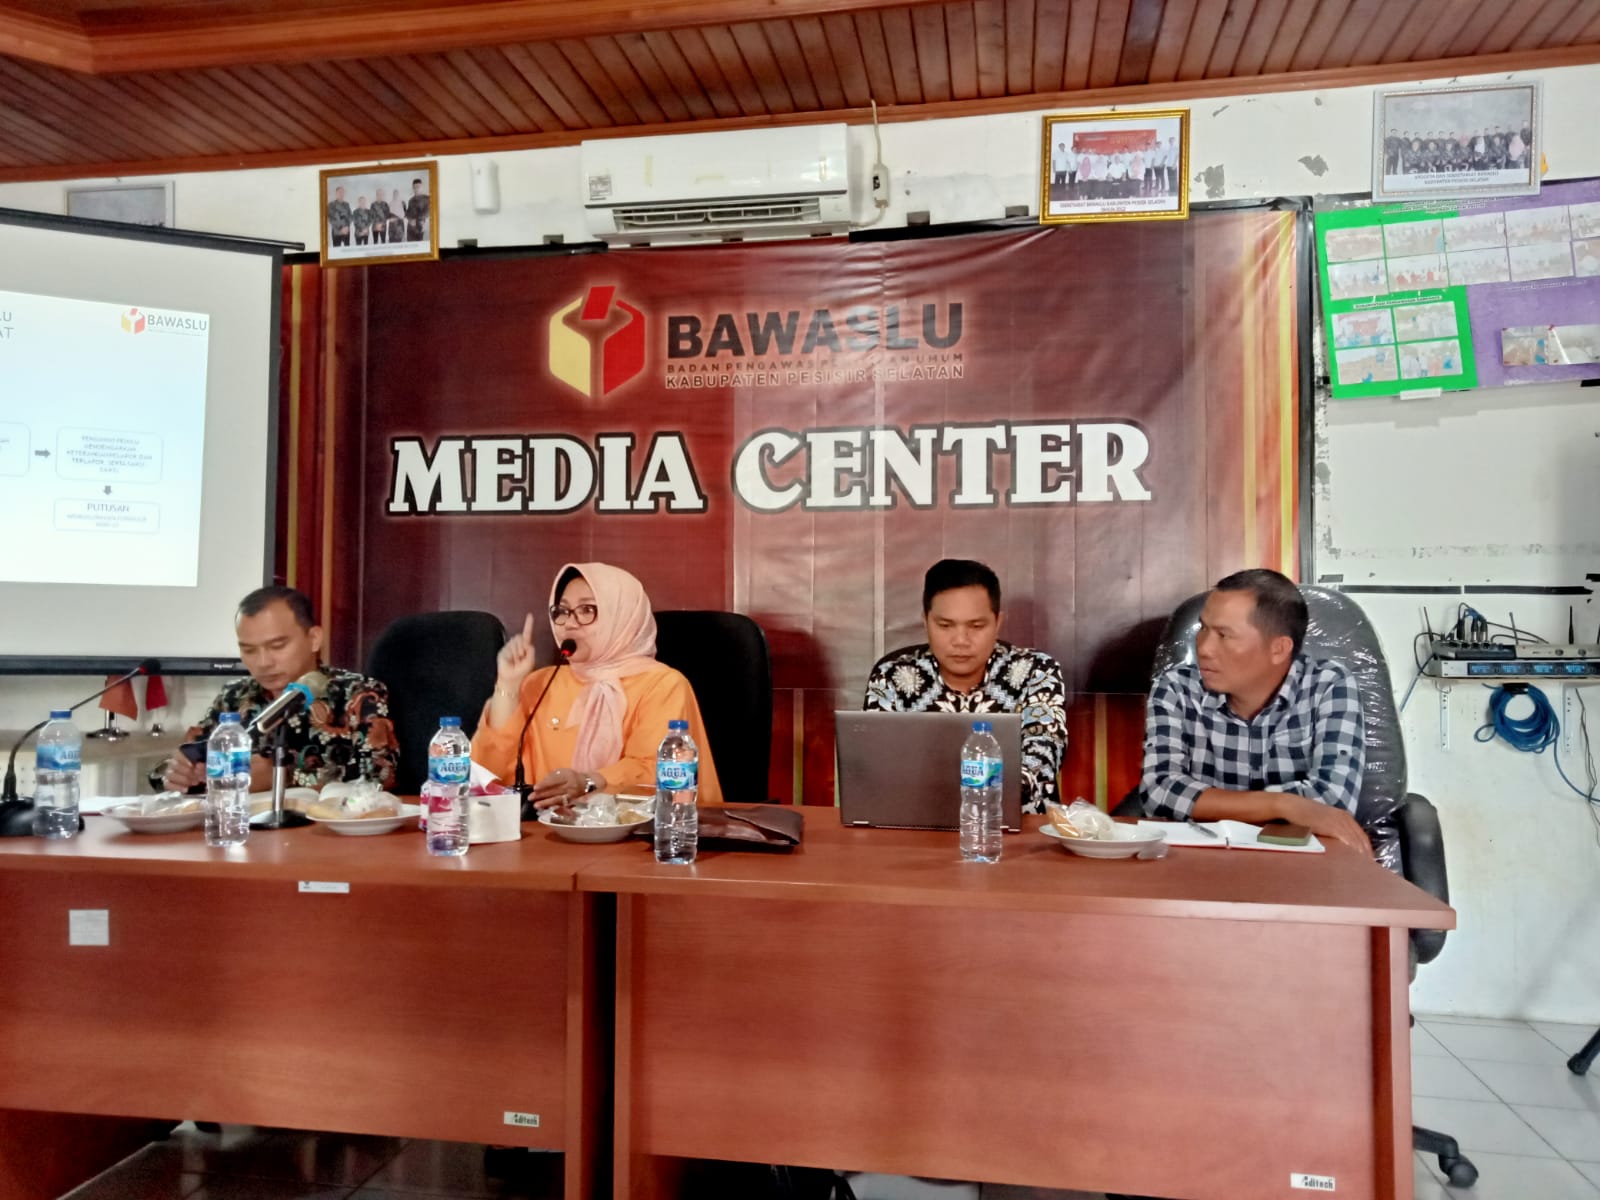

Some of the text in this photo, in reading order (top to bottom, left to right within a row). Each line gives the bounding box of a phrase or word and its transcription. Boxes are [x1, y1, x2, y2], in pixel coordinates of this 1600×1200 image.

[147, 314, 207, 331] BAWASLU
[667, 302, 963, 359] BAWASLU
[667, 363, 720, 374] BADAN
[726, 359, 814, 372] PENGAWAS
[665, 364, 964, 389] KABUPATEN PESISIR SELATAN
[386, 418, 1153, 516] MEDIA CENTER
[87, 502, 130, 513] PUTUSAN
[661, 767, 687, 779] AQUA
